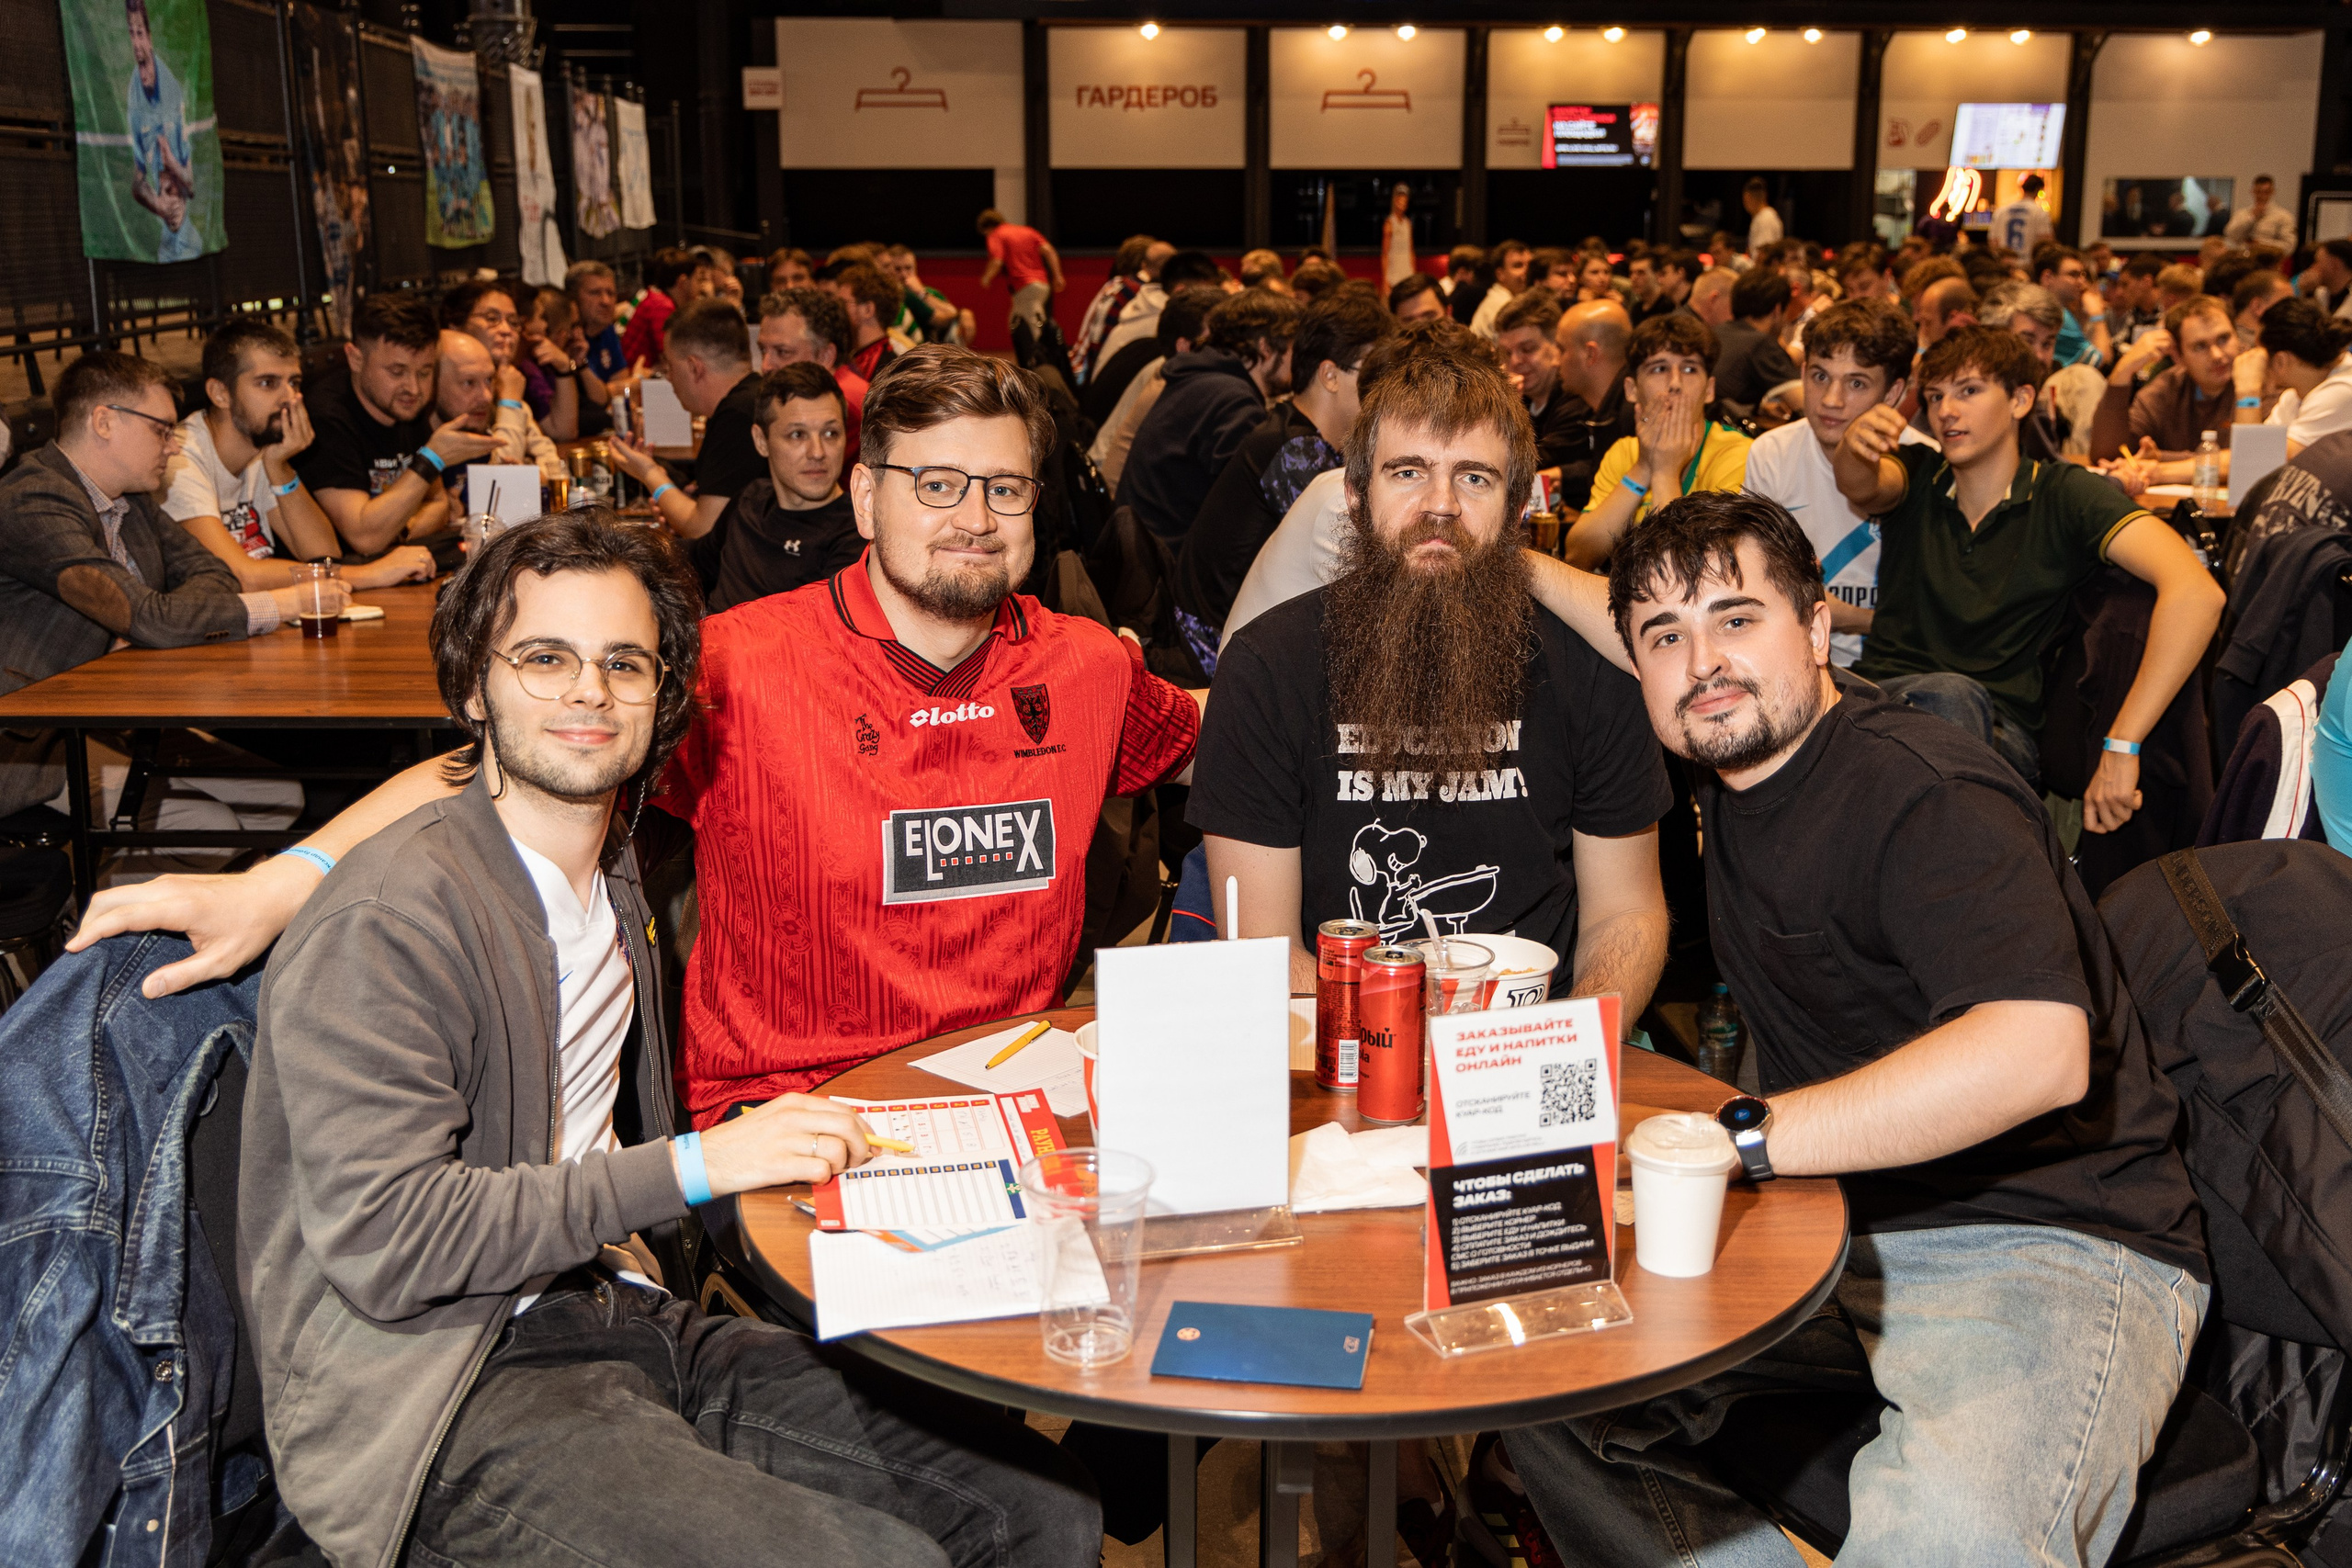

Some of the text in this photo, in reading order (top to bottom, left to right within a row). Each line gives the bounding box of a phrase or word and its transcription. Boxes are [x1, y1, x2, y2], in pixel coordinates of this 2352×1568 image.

[1076, 85, 1218, 111] ГАРДЕРОБ
[854, 713, 873, 731] The
[929, 702, 995, 727] lotto
[856, 729, 880, 744] Crazy
[1013, 745, 1057, 758] WIMBLEDON
[1337, 767, 1529, 803] IS MY JAM!
[905, 809, 1044, 882] ELONEX
[1360, 1027, 1393, 1048] рый
[1456, 1018, 1574, 1042] ЗАКАЗЫВАЙТЕ
[1455, 1033, 1577, 1057] ЕДУ И НАПИТКИ
[1455, 1055, 1521, 1073] ОНЛАЙН
[1453, 1163, 1586, 1191] ЧТОБЫ СДЕЛАТЬ
[1453, 1189, 1512, 1209] ЗАКАЗ:
